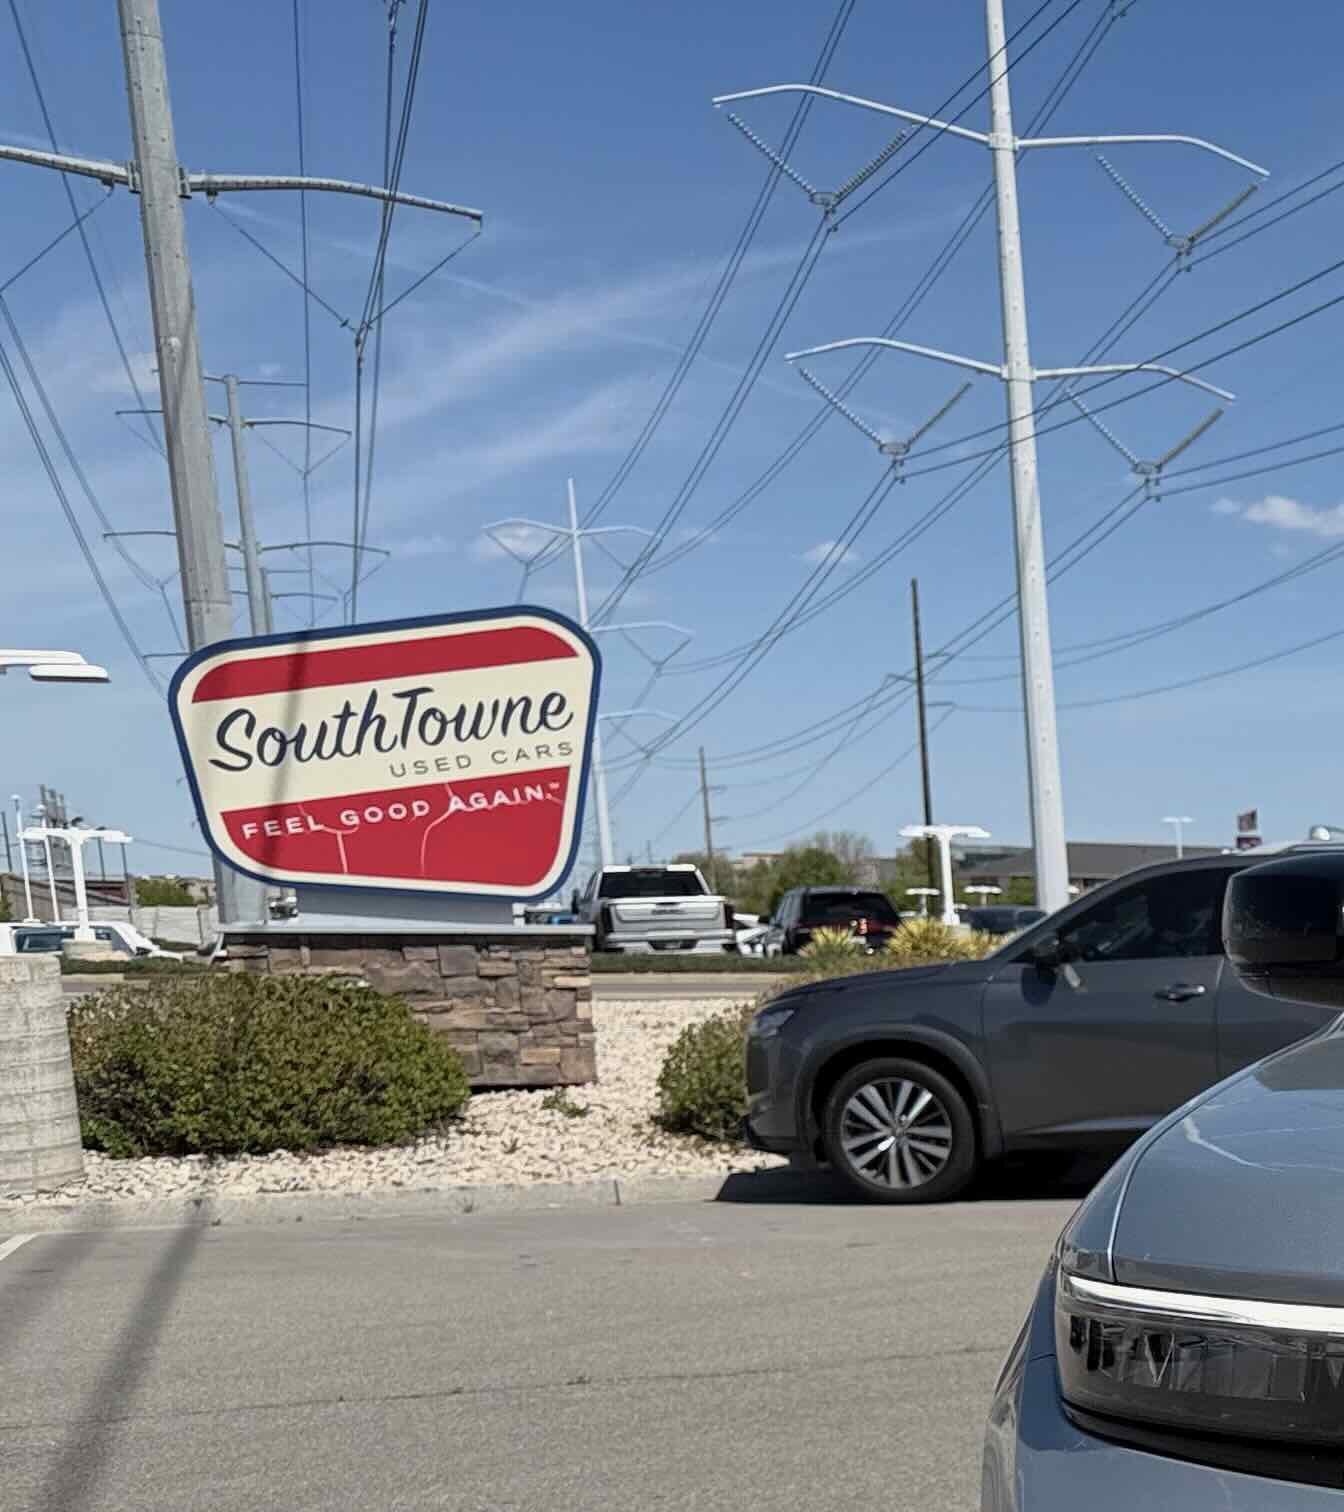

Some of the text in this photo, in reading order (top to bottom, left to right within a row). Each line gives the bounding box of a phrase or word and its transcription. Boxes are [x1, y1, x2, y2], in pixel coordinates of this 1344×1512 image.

[209, 687, 573, 772] SouthTowne
[390, 742, 573, 778] USED CARS
[242, 815, 324, 839] FEEL
[340, 800, 430, 826] GOOD
